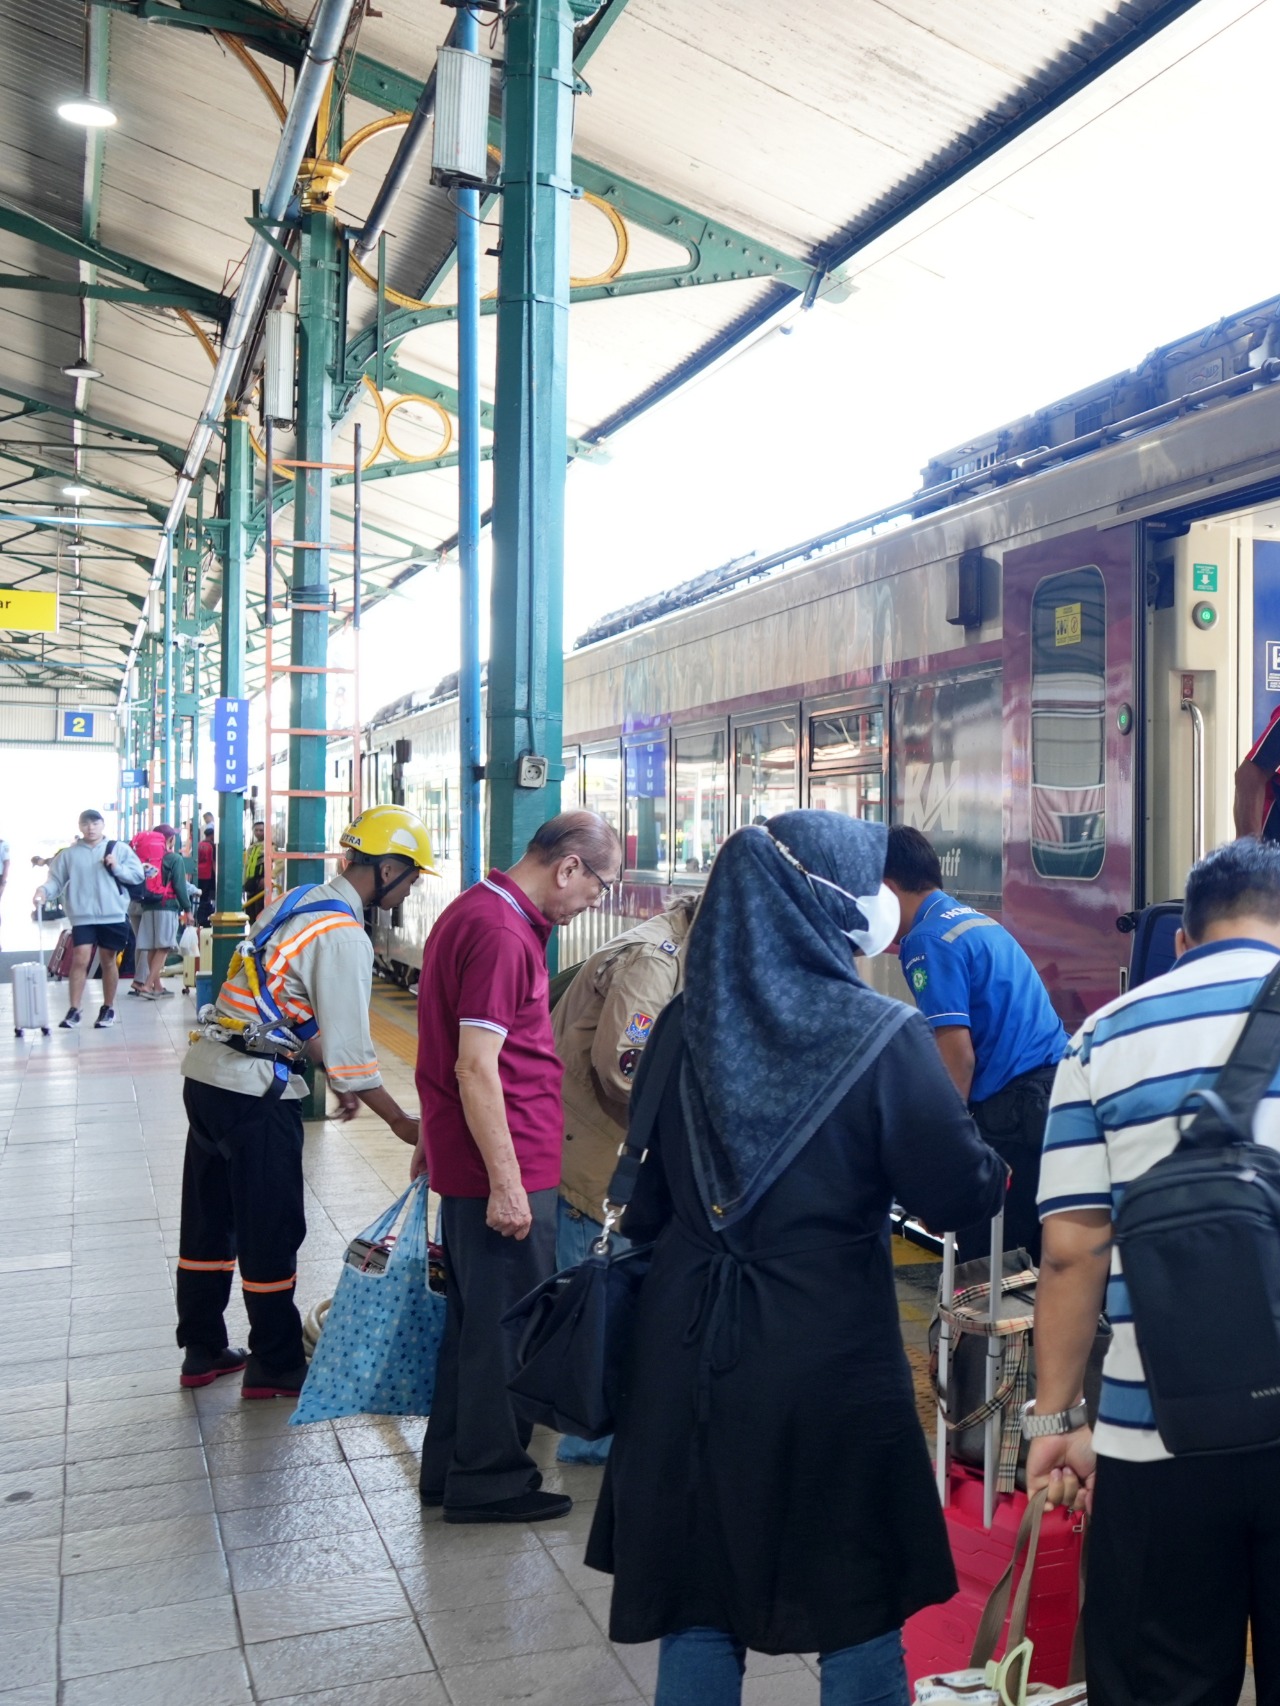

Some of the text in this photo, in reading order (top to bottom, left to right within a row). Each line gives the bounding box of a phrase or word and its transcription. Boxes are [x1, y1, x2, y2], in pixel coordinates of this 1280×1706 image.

[72, 717, 86, 733] 2
[226, 702, 238, 784] MADIUN
[904, 760, 960, 831] KAI
